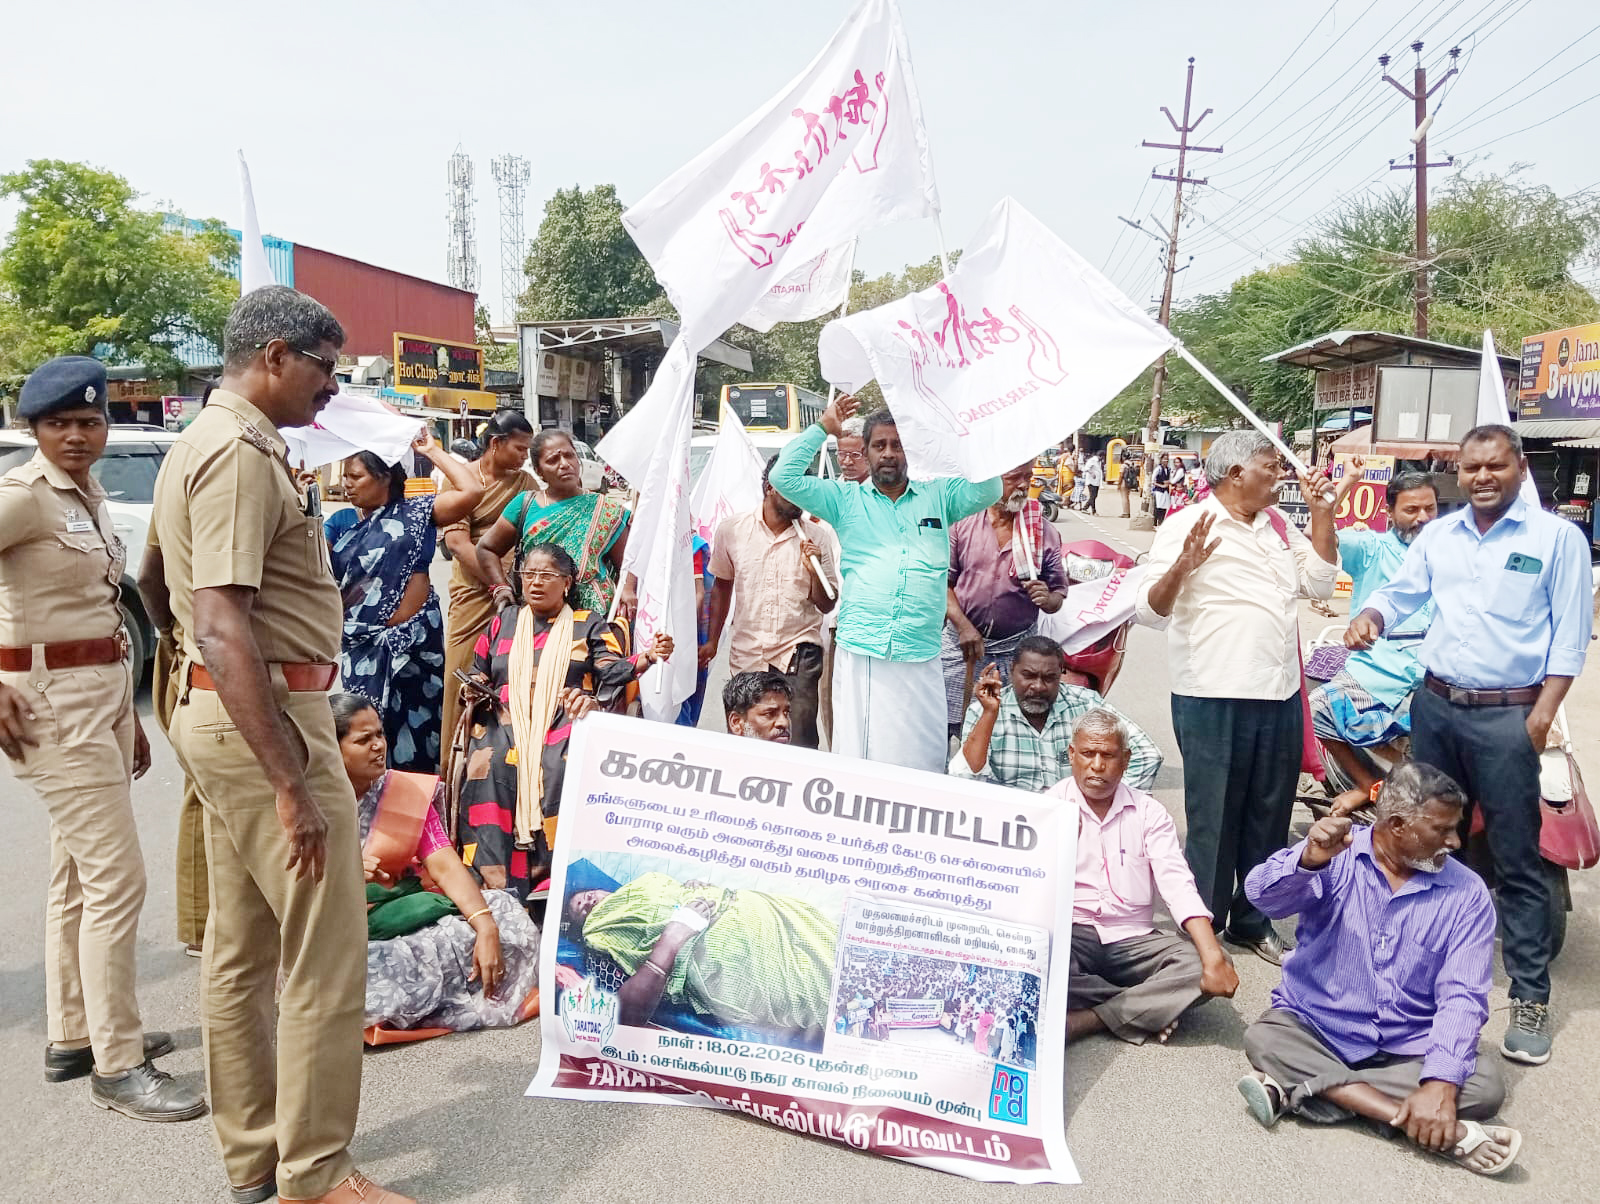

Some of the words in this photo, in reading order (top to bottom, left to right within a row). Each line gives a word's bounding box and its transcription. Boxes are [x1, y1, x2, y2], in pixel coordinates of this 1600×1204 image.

[399, 361, 414, 378] Hot
[415, 363, 438, 384] Chips
[1573, 338, 1599, 362] Jana
[599, 749, 793, 808] கண்டன
[802, 777, 1038, 851] போராட்டம்
[585, 792, 686, 817] தங்களுடைய
[689, 808, 758, 830] உரிமைத்
[761, 820, 823, 842] தொகை
[826, 832, 889, 855] உயர்த்தி
[892, 844, 937, 864] கேட்டு
[940, 854, 1047, 880] சென்னையில்
[605, 811, 663, 834] போராடி
[666, 823, 709, 841] வரும்
[712, 832, 793, 857] அனைத்து
[796, 847, 839, 863] வகை
[842, 855, 1020, 895] மாற்றுத்திறனாளிகளை
[626, 836, 746, 868] அலைக்கழித்து
[749, 857, 793, 875] வரும்
[795, 866, 850, 885] தமிழக
[854, 875, 910, 895] அரசை
[913, 887, 992, 911] கண்டித்து
[574, 1019, 602, 1034] TARATDAC
[601, 1045, 639, 1063] இடம்
[650, 1054, 747, 1082] செங்கல்பட்டு
[750, 1071, 788, 1087] நகர
[791, 1077, 849, 1095] காவல்
[851, 1084, 932, 1106] நிலையம்
[935, 1099, 982, 1122] முன்பு
[658, 1034, 695, 1050] நாள்
[706, 1039, 805, 1066] 18.02.2026
[808, 1057, 918, 1081] புதன்கிழமை
[877, 1117, 1012, 1162] மாவட்டம்
